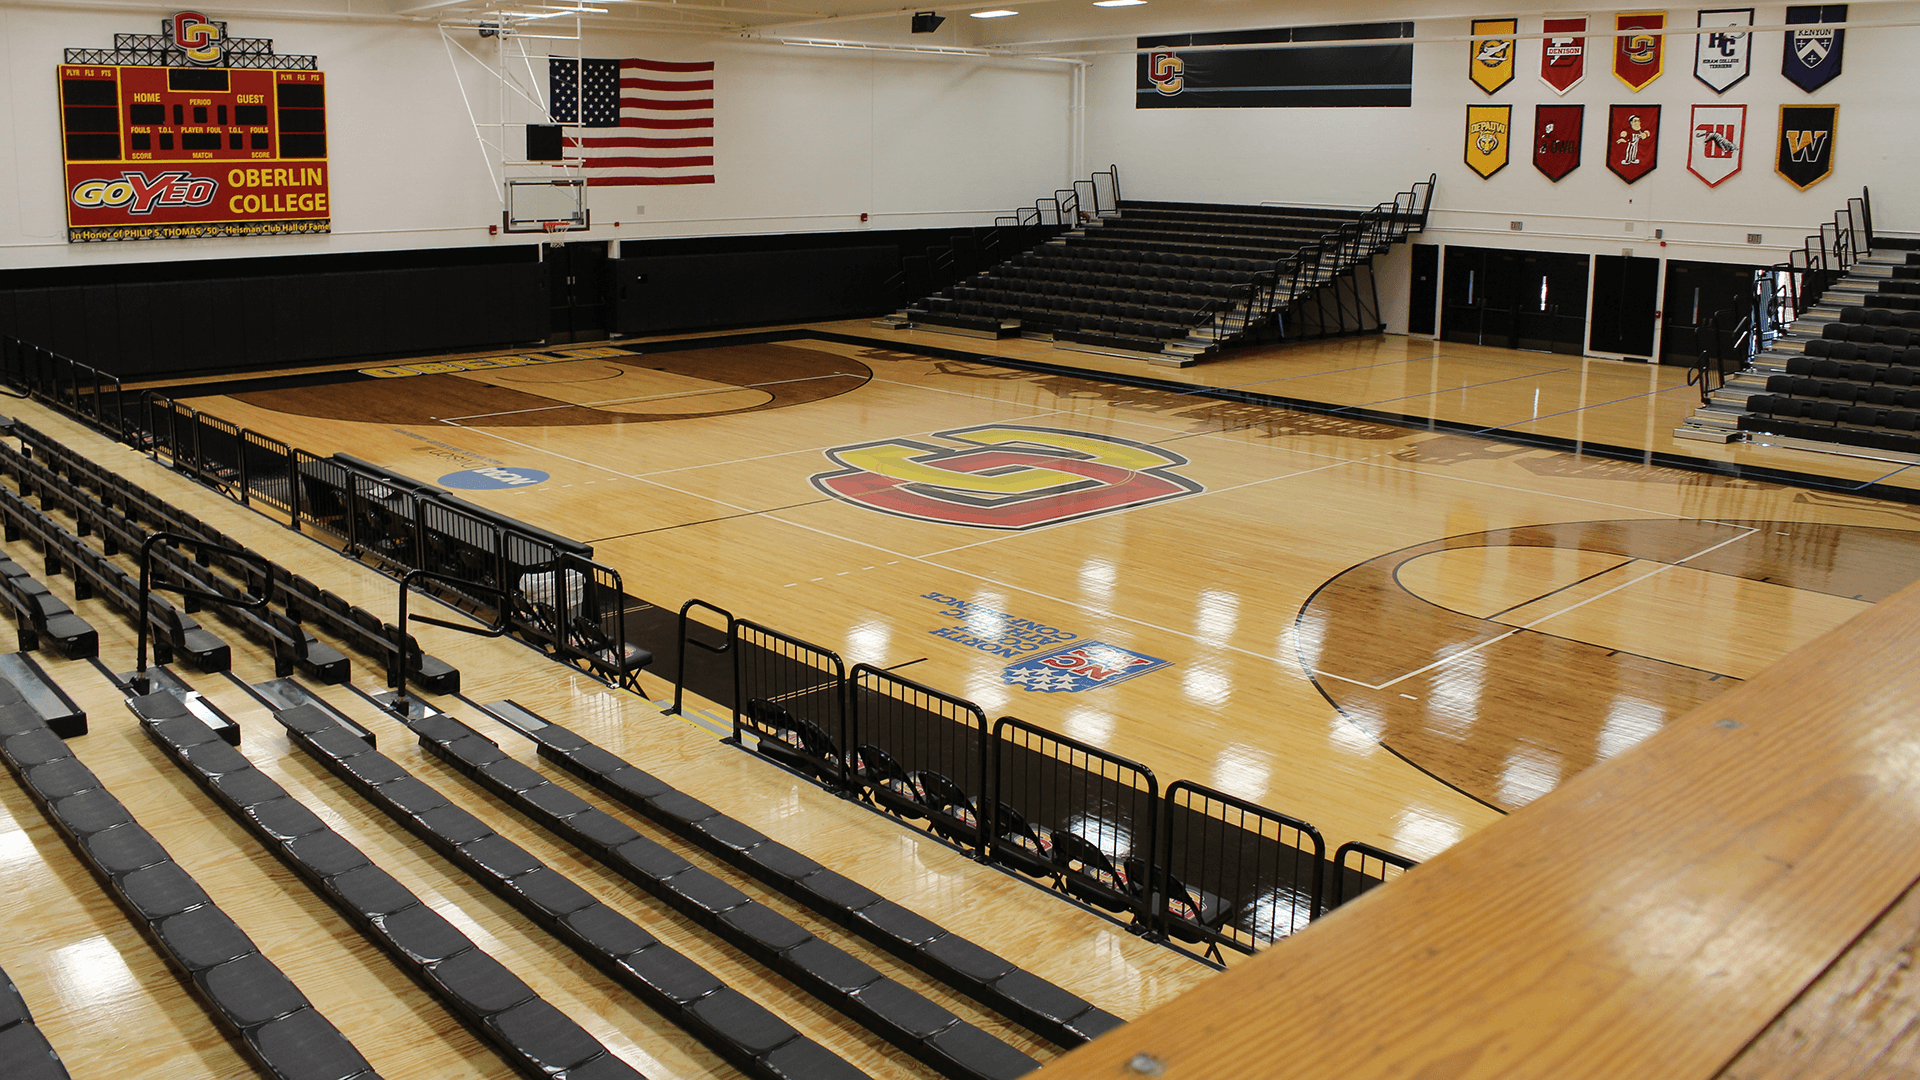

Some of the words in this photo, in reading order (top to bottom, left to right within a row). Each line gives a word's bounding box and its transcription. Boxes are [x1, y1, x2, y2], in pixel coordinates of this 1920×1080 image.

[1548, 47, 1580, 56] DENISON
[66, 69, 80, 77] PLYR
[85, 69, 94, 77] FLS
[101, 69, 111, 77] PTS
[134, 93, 161, 103] HOME
[189, 98, 211, 106] PERIOD
[236, 94, 264, 104] GUEST
[1786, 130, 1828, 162] W
[227, 168, 323, 188] OBERLIN
[229, 193, 327, 214] COLLEGE
[72, 231, 81, 240] In
[83, 231, 111, 240] Honor
[113, 229, 123, 239] of
[124, 228, 153, 238] PHILIP
[154, 228, 162, 237] S.
[163, 227, 201, 237] THOMAS
[225, 225, 261, 235] Heisman
[262, 224, 281, 233] Club
[282, 223, 299, 232] Hall
[299, 222, 308, 231] of
[309, 222, 330, 231] Fame
[358, 346, 643, 379] OBERLIN
[939, 608, 1063, 646] ATHIC
[928, 627, 1023, 659] NORTH
